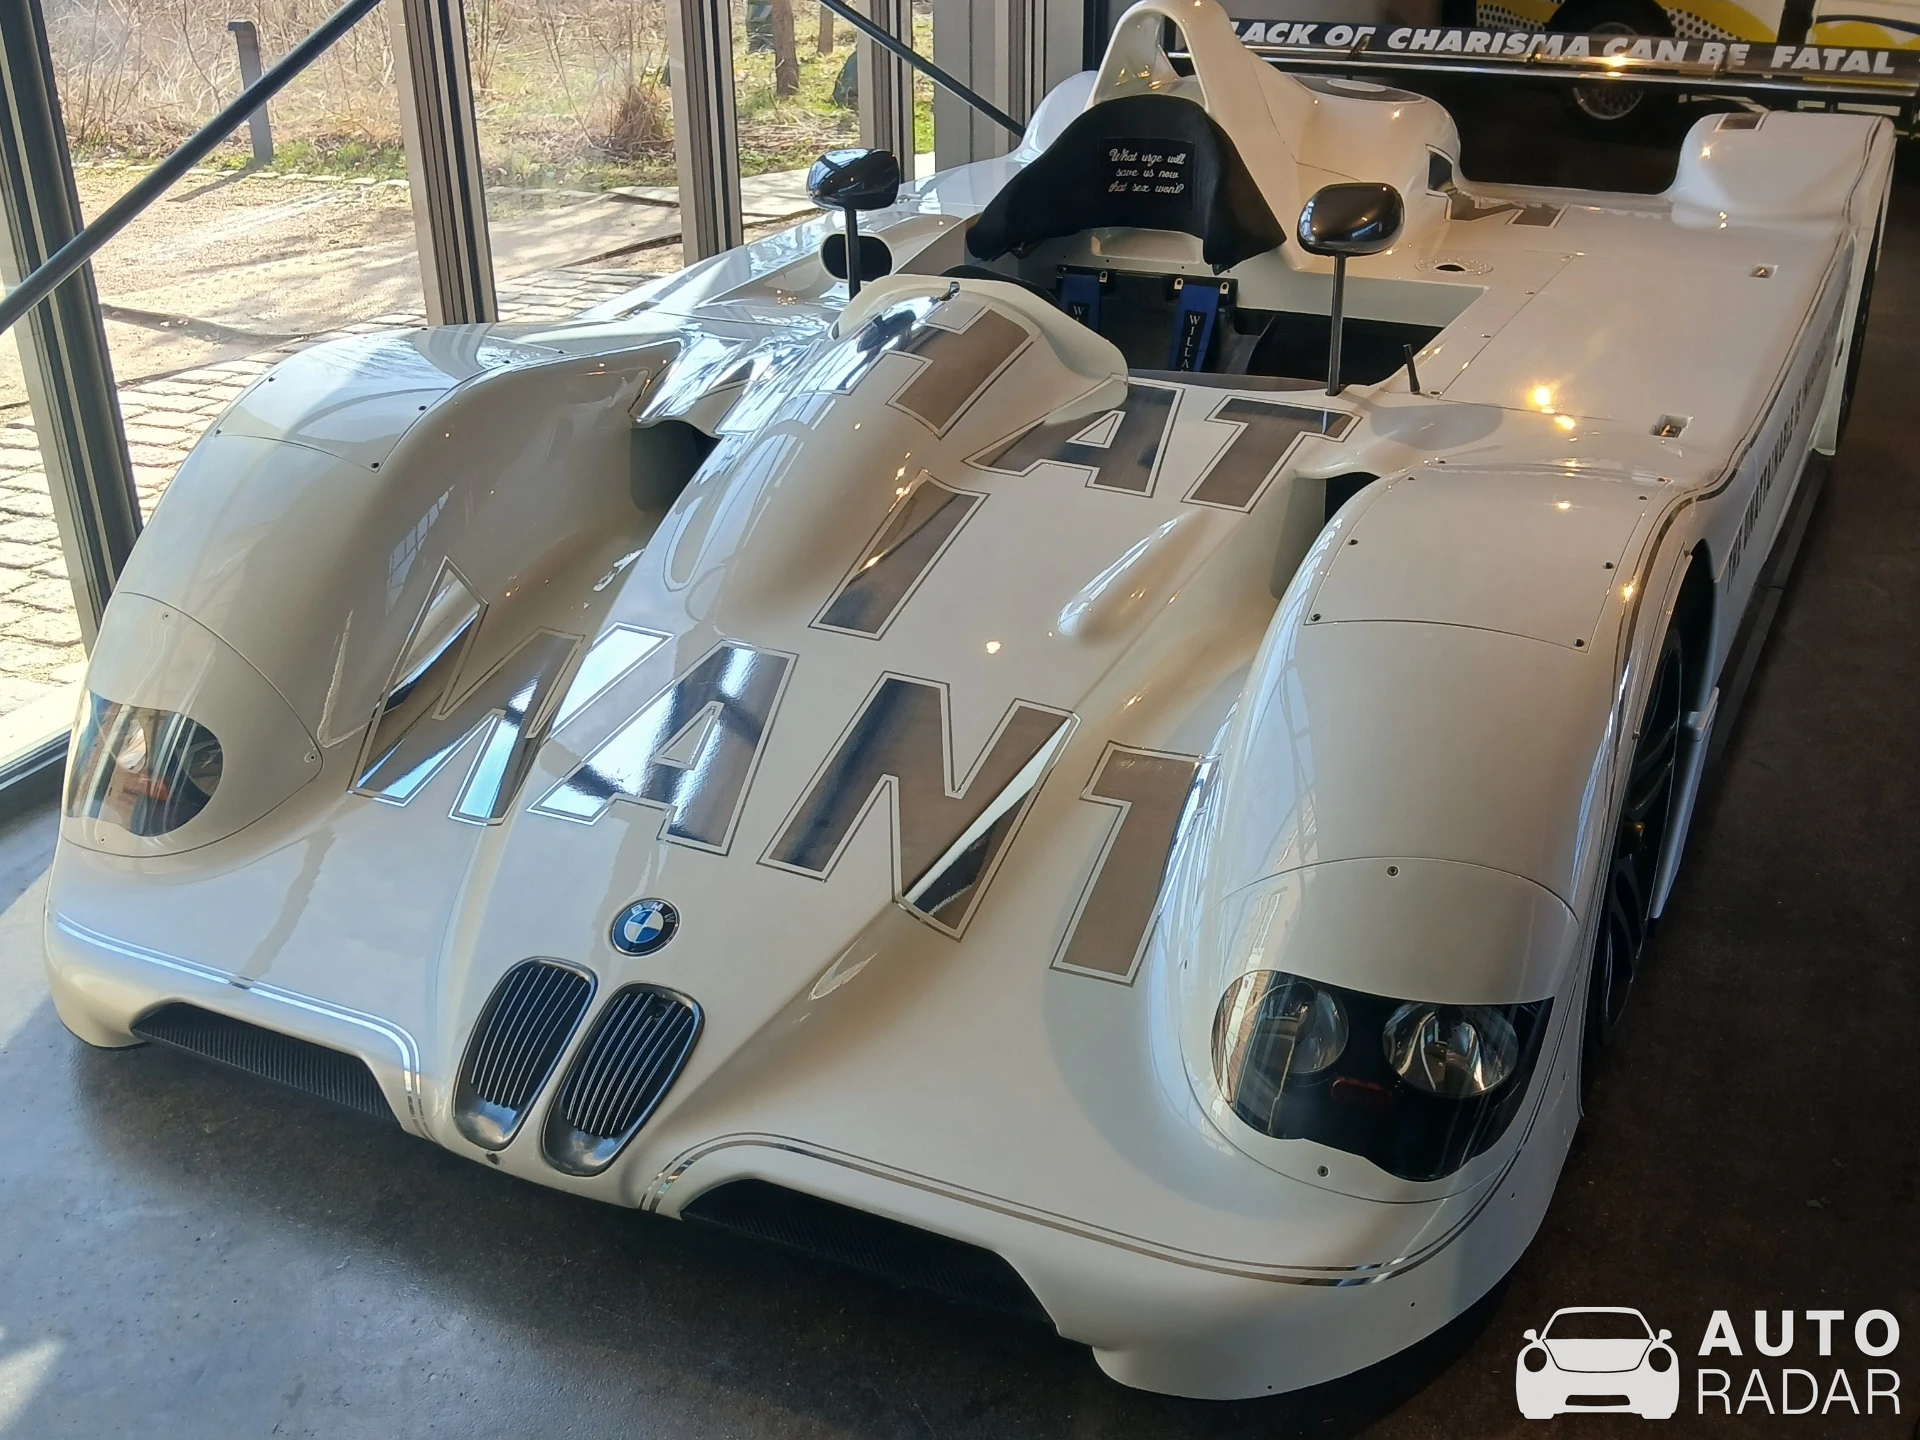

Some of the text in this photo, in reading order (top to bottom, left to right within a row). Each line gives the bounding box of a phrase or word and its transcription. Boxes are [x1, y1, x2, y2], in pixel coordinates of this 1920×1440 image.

[1324, 25, 1376, 48] OF
[1387, 27, 1590, 58] CHARISMA
[1602, 37, 1688, 64] CAN
[1697, 42, 1750, 68] BE
[1770, 45, 1895, 75] FATAL
[1109, 148, 1187, 167] What urge will
[1116, 168, 1180, 179] save us now
[1108, 180, 1127, 193] that
[1132, 183, 1151, 192] sex
[1181, 314, 1201, 372] WILLA
[630, 901, 676, 923] BMW
